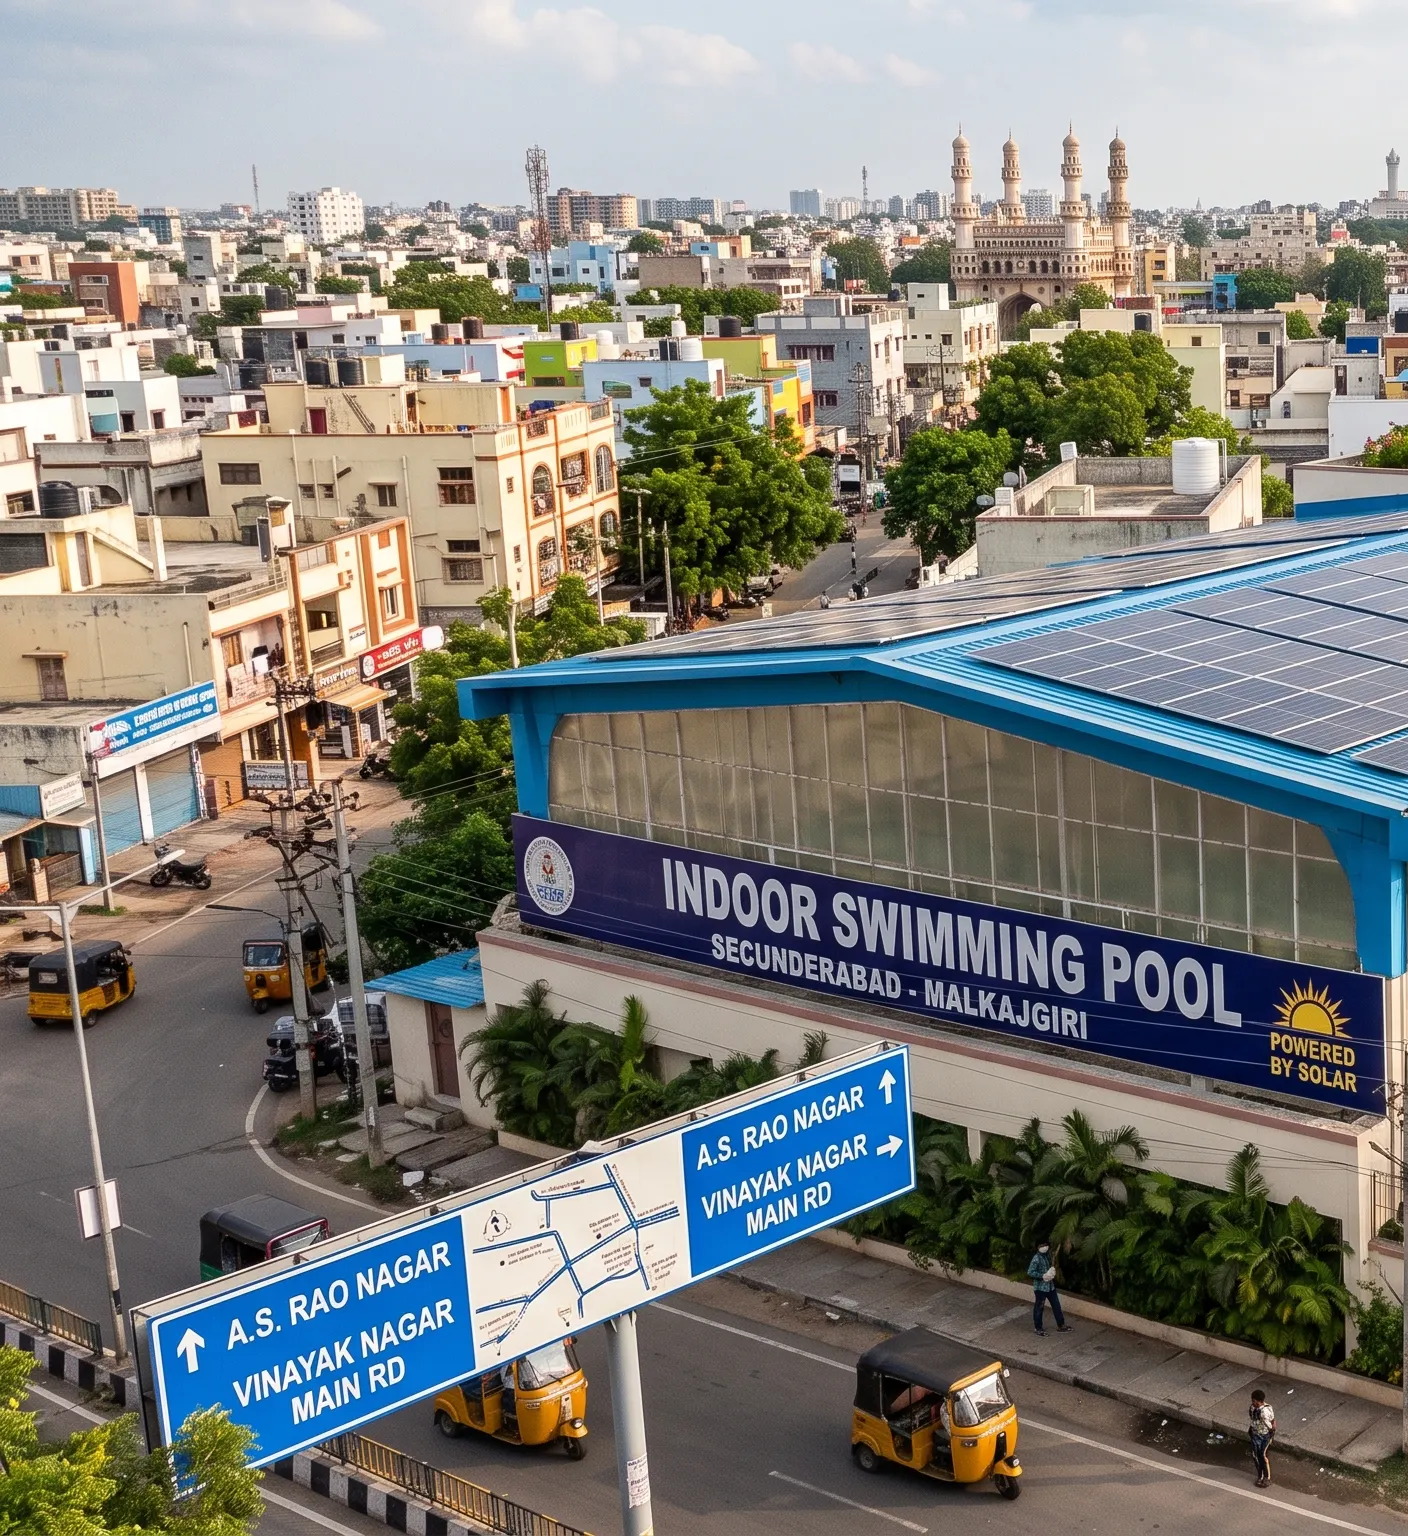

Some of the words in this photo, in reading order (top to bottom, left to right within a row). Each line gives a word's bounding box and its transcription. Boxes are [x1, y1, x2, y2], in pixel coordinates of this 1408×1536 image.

[662, 857, 821, 942] INDOOR
[832, 890, 1086, 996] SWIMMING
[1102, 942, 1242, 1028] POOL
[711, 933, 902, 999] SECUNDERABAD
[924, 978, 1088, 1041] MALKAJGIRI
[1270, 1032, 1357, 1068] POWERED
[1270, 1055, 1293, 1078] BY
[1298, 1062, 1358, 1094] SOLAR
[697, 1134, 737, 1172] A.S.
[742, 1114, 788, 1153] RAO
[793, 1085, 865, 1133] NAGAR
[701, 1162, 793, 1220] VINAYAK
[797, 1133, 868, 1183] NAGAR
[746, 1193, 799, 1236] MAIN
[803, 1181, 832, 1213] RD
[227, 1307, 283, 1351] A.S.
[289, 1278, 350, 1326] RAO
[356, 1241, 452, 1300] NAGAR
[232, 1335, 355, 1408] VINAYAK
[360, 1298, 455, 1359] NAGAR
[291, 1371, 361, 1425] MAIN
[368, 1356, 406, 1393] RD
